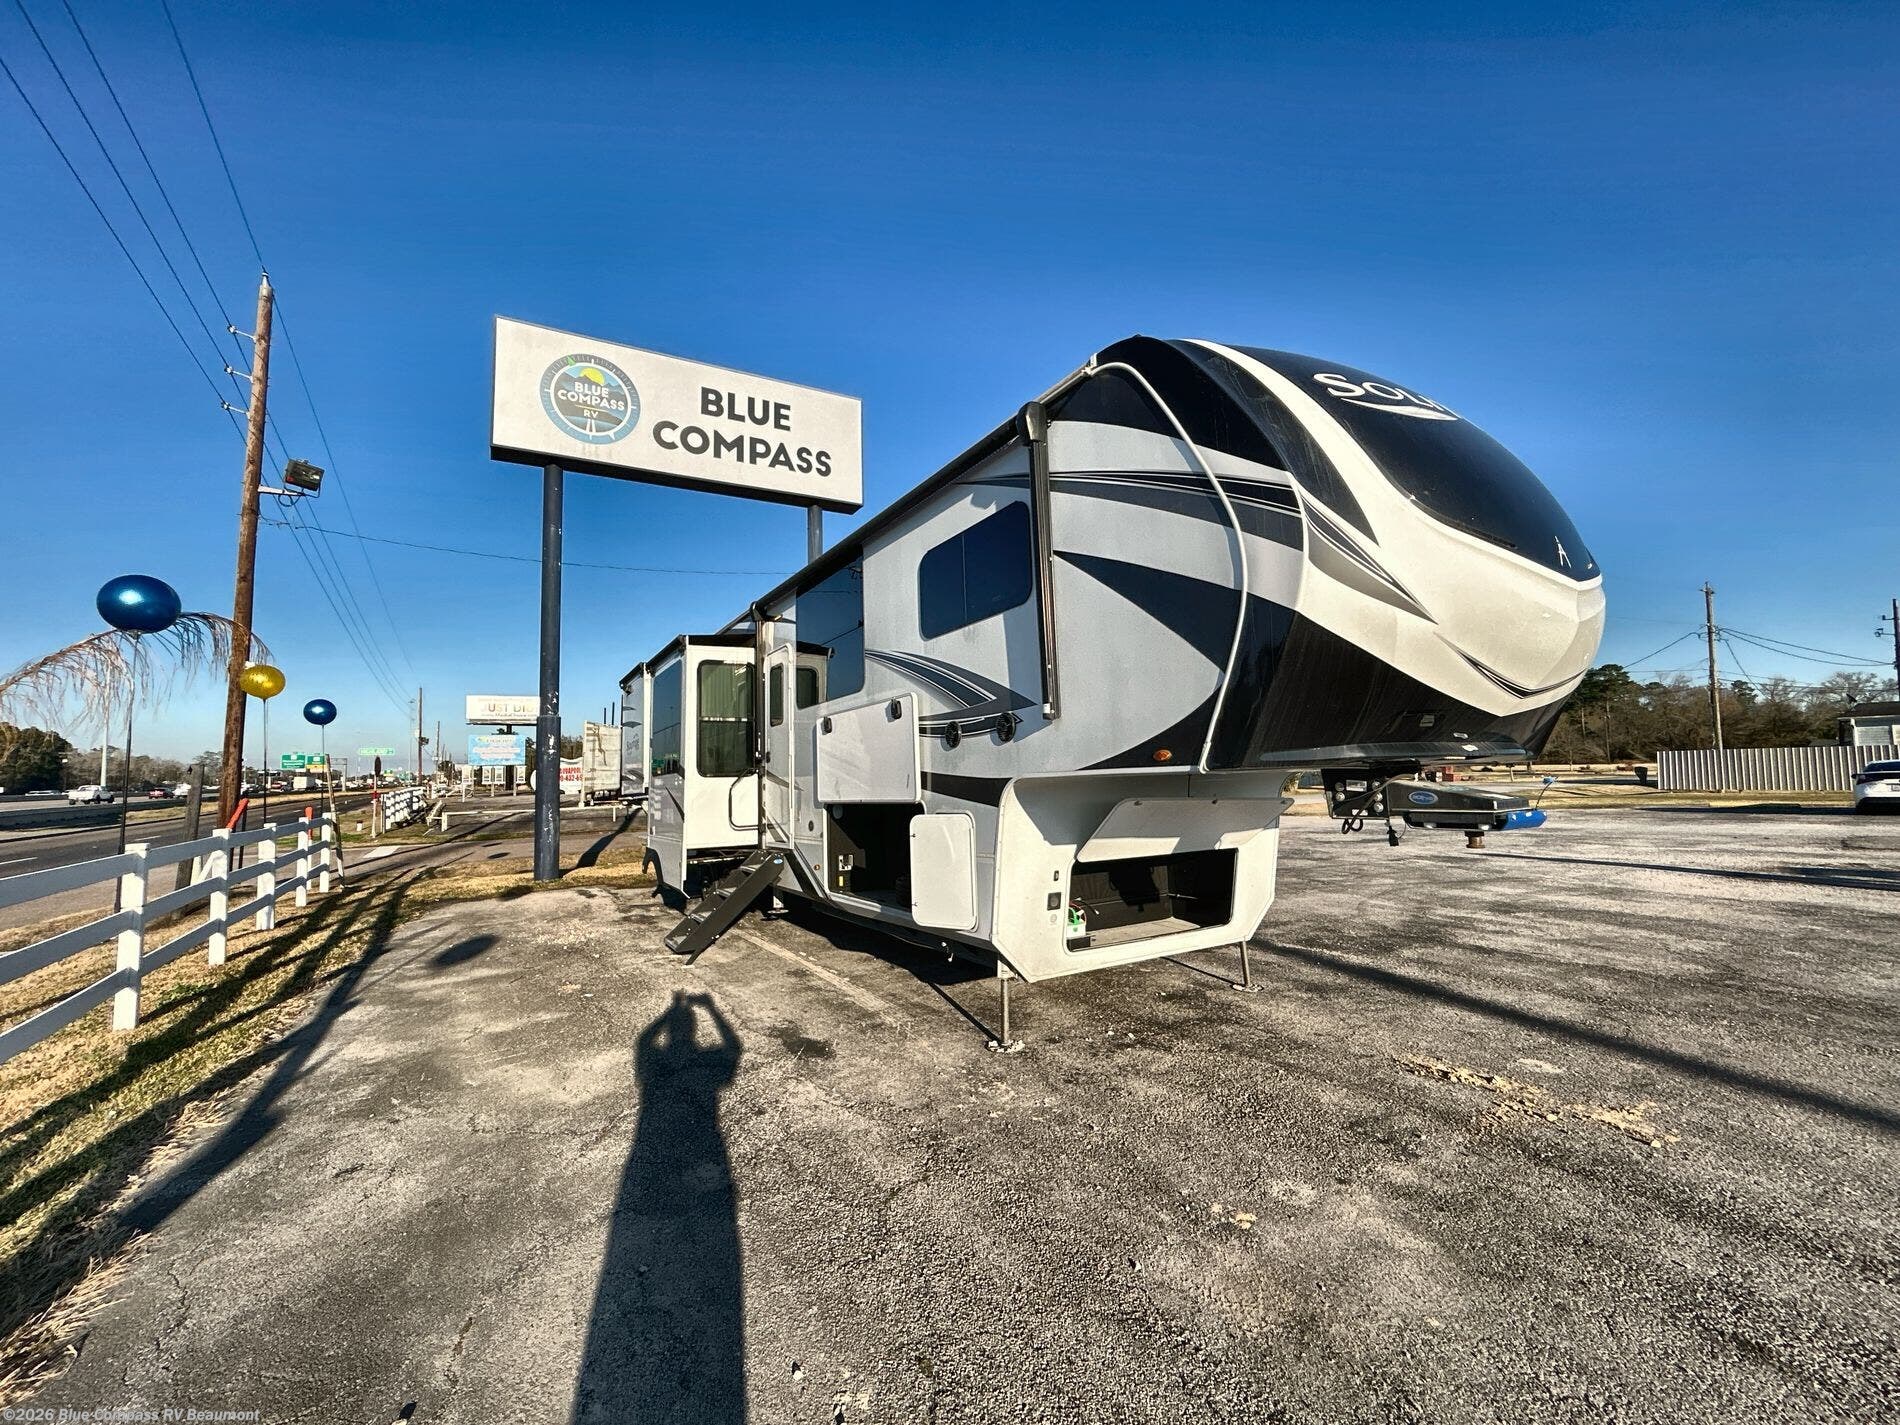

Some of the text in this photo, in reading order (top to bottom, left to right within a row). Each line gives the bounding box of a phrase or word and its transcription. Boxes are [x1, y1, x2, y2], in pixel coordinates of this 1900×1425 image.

[557, 389, 625, 411] COMPASS
[575, 381, 609, 398] BLUE
[584, 409, 599, 418] RV
[701, 386, 791, 431] BLUE
[653, 420, 831, 477] COMPASS
